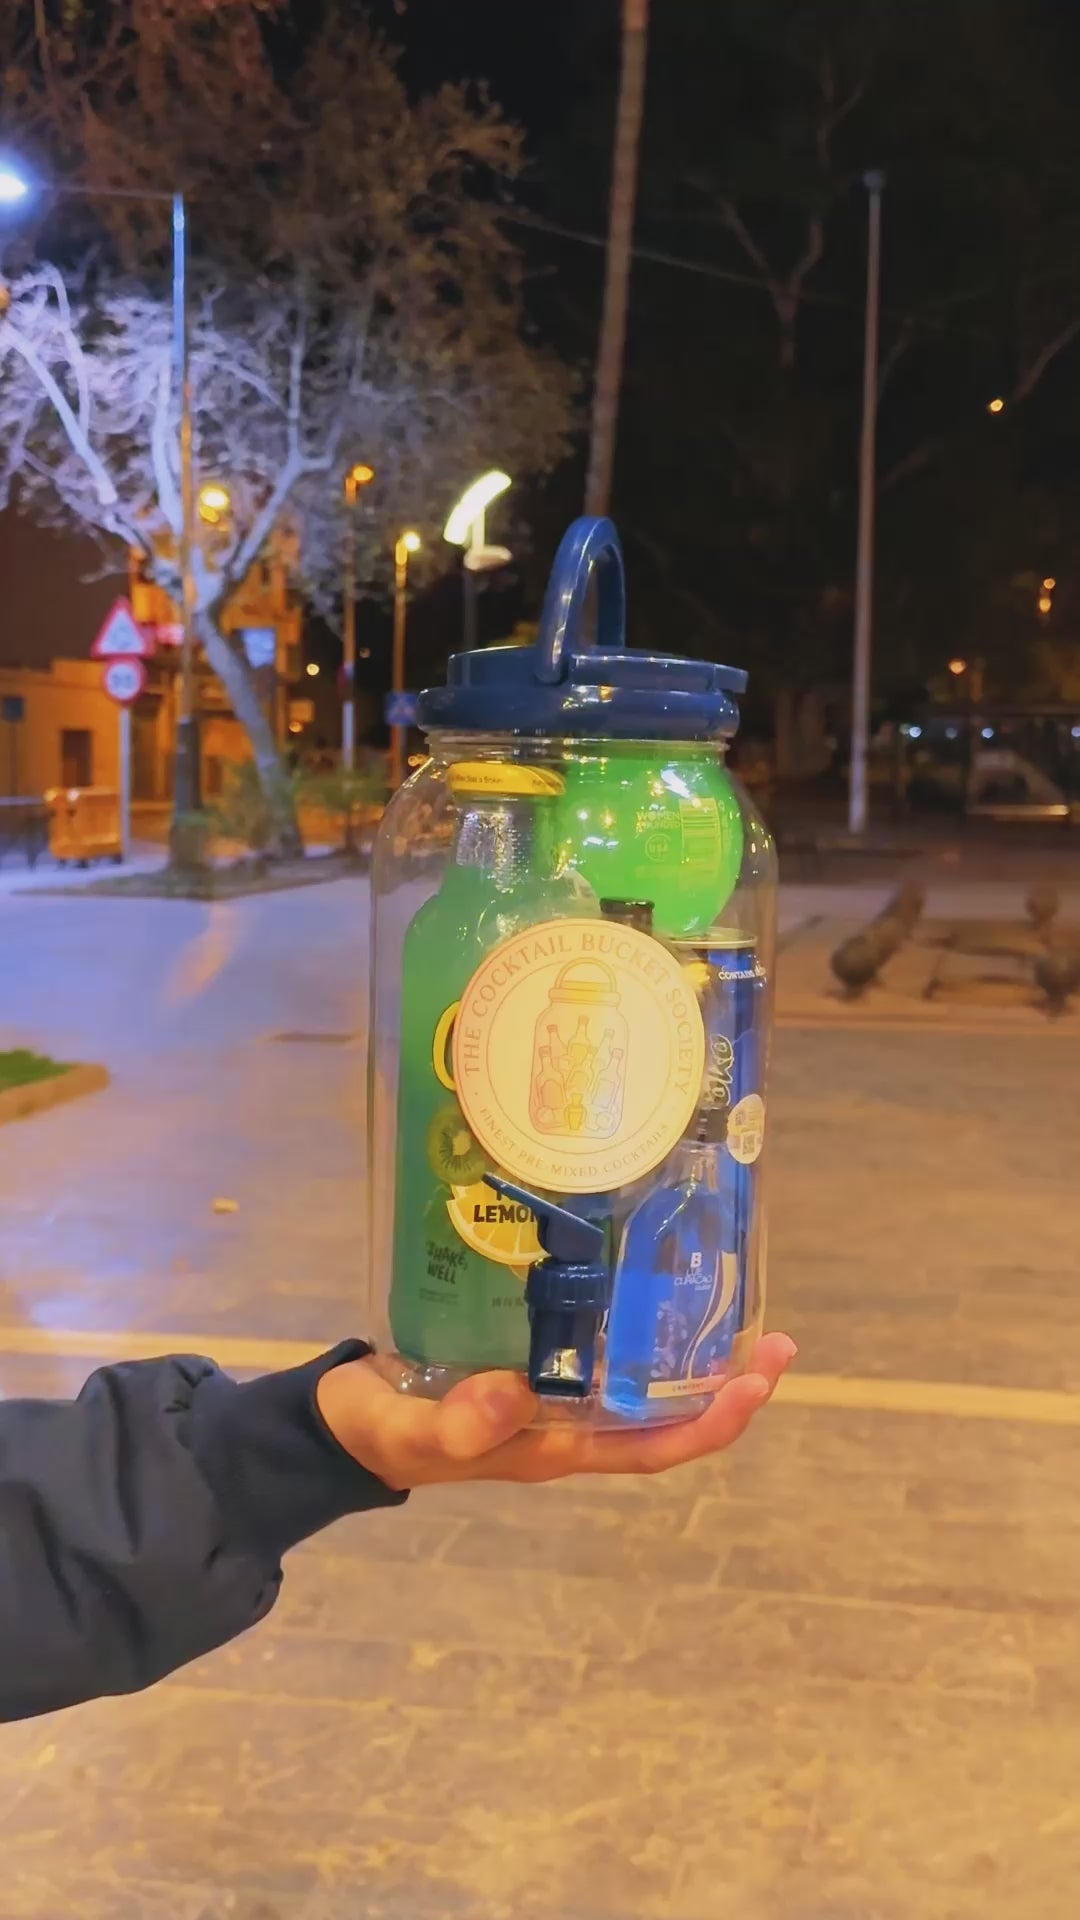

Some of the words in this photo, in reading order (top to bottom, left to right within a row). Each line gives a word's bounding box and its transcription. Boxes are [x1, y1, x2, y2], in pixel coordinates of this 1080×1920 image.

[471, 934, 573, 1019] COCKTAIL
[581, 932, 672, 986] BUCKET
[463, 1026, 482, 1077] THE
[664, 986, 695, 1096] SOCIETY
[479, 1107, 517, 1153] FINEST
[603, 1123, 670, 1174] COCKTAILS
[427, 1261, 457, 1285] WELL
